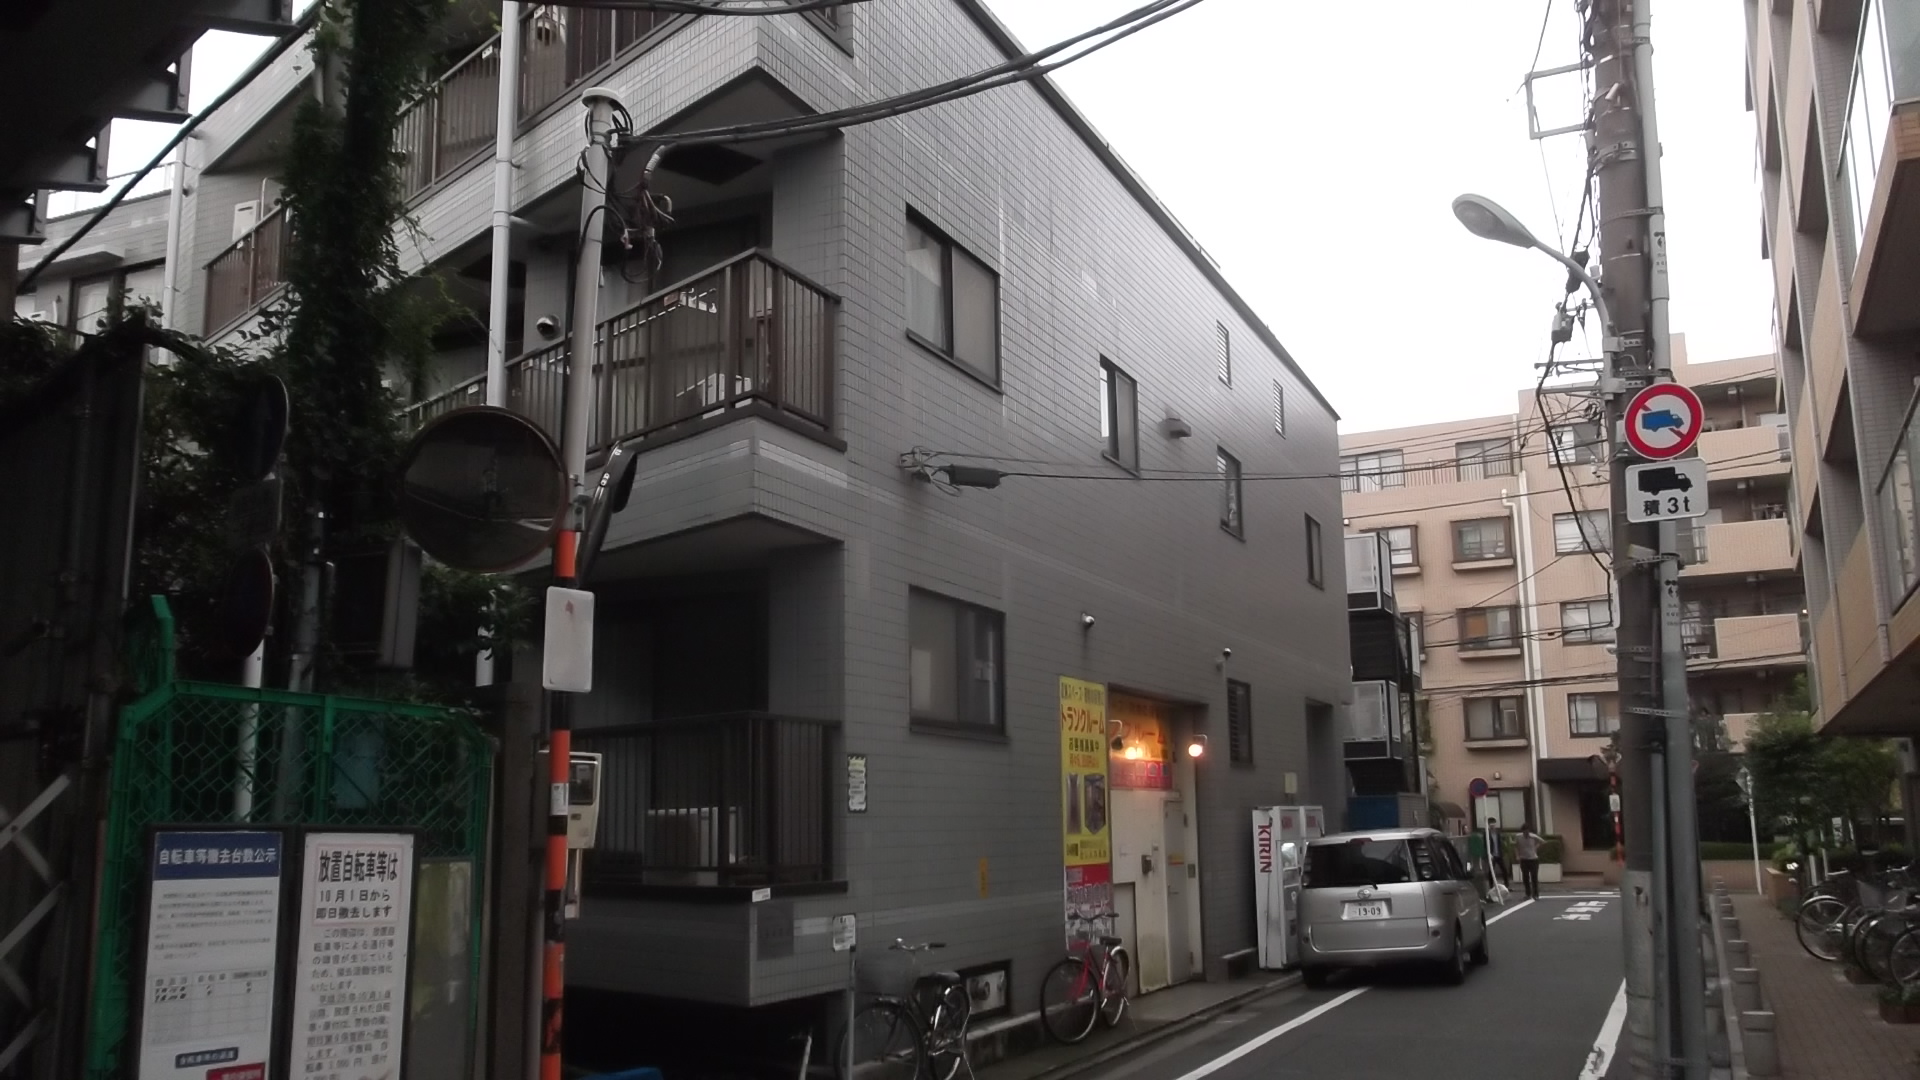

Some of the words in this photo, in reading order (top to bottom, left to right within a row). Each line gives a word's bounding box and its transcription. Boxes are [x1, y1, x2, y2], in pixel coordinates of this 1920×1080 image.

[1061, 704, 1104, 735] トランクルーム
[1257, 824, 1272, 873] KIRIN
[317, 849, 398, 882] 放置自転車等は
